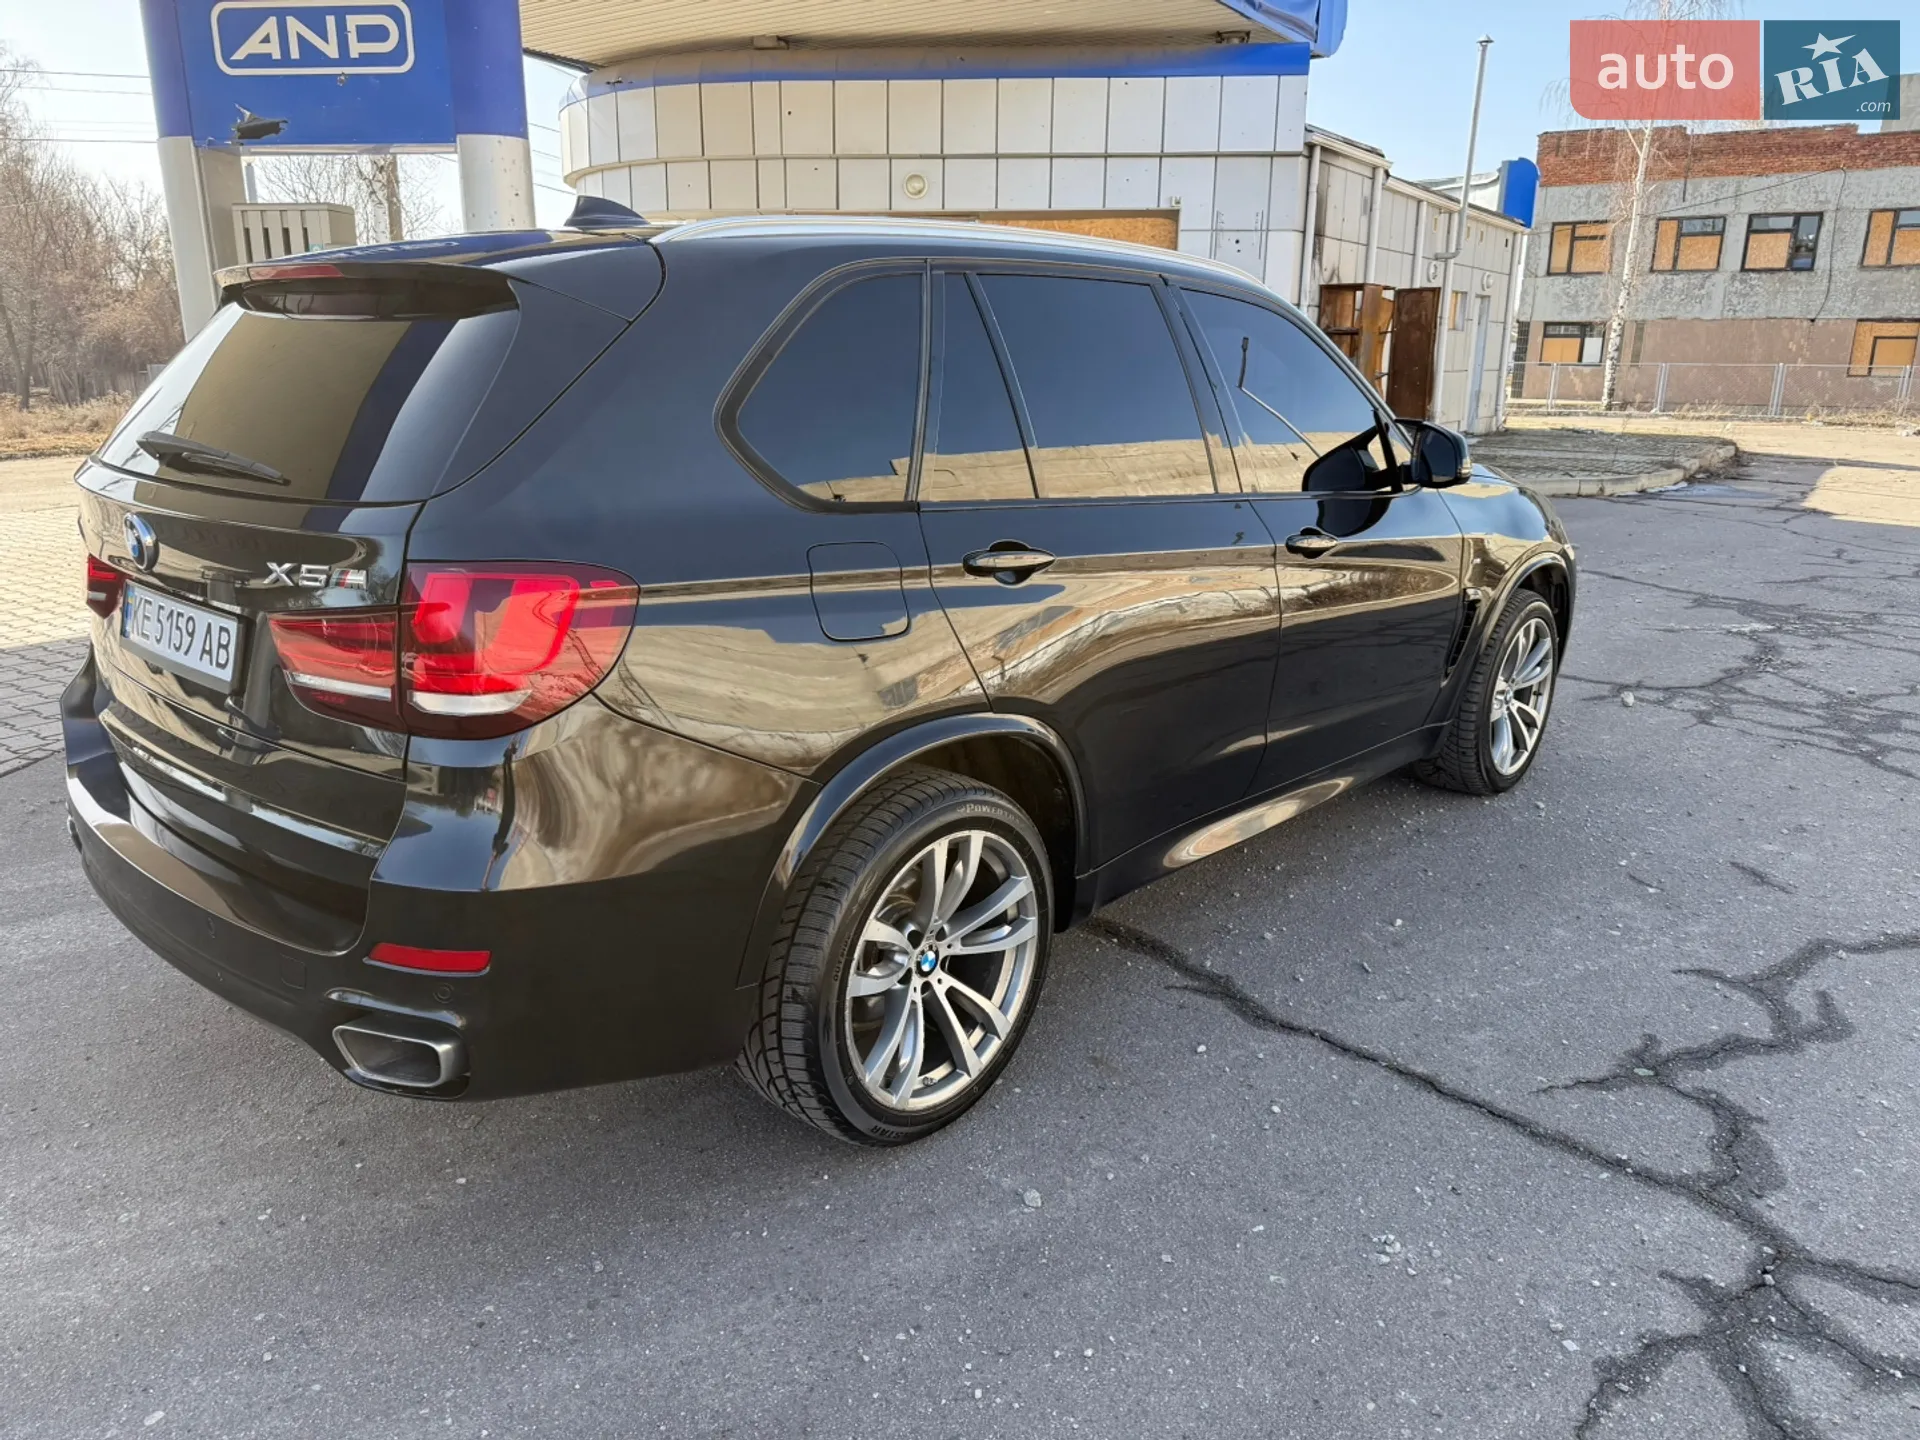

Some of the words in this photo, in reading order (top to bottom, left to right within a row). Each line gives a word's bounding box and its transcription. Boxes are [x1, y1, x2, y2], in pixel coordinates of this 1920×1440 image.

[263, 561, 331, 588] X5
[131, 592, 153, 641] KE
[154, 603, 196, 657] 5159
[199, 620, 231, 670] AB
